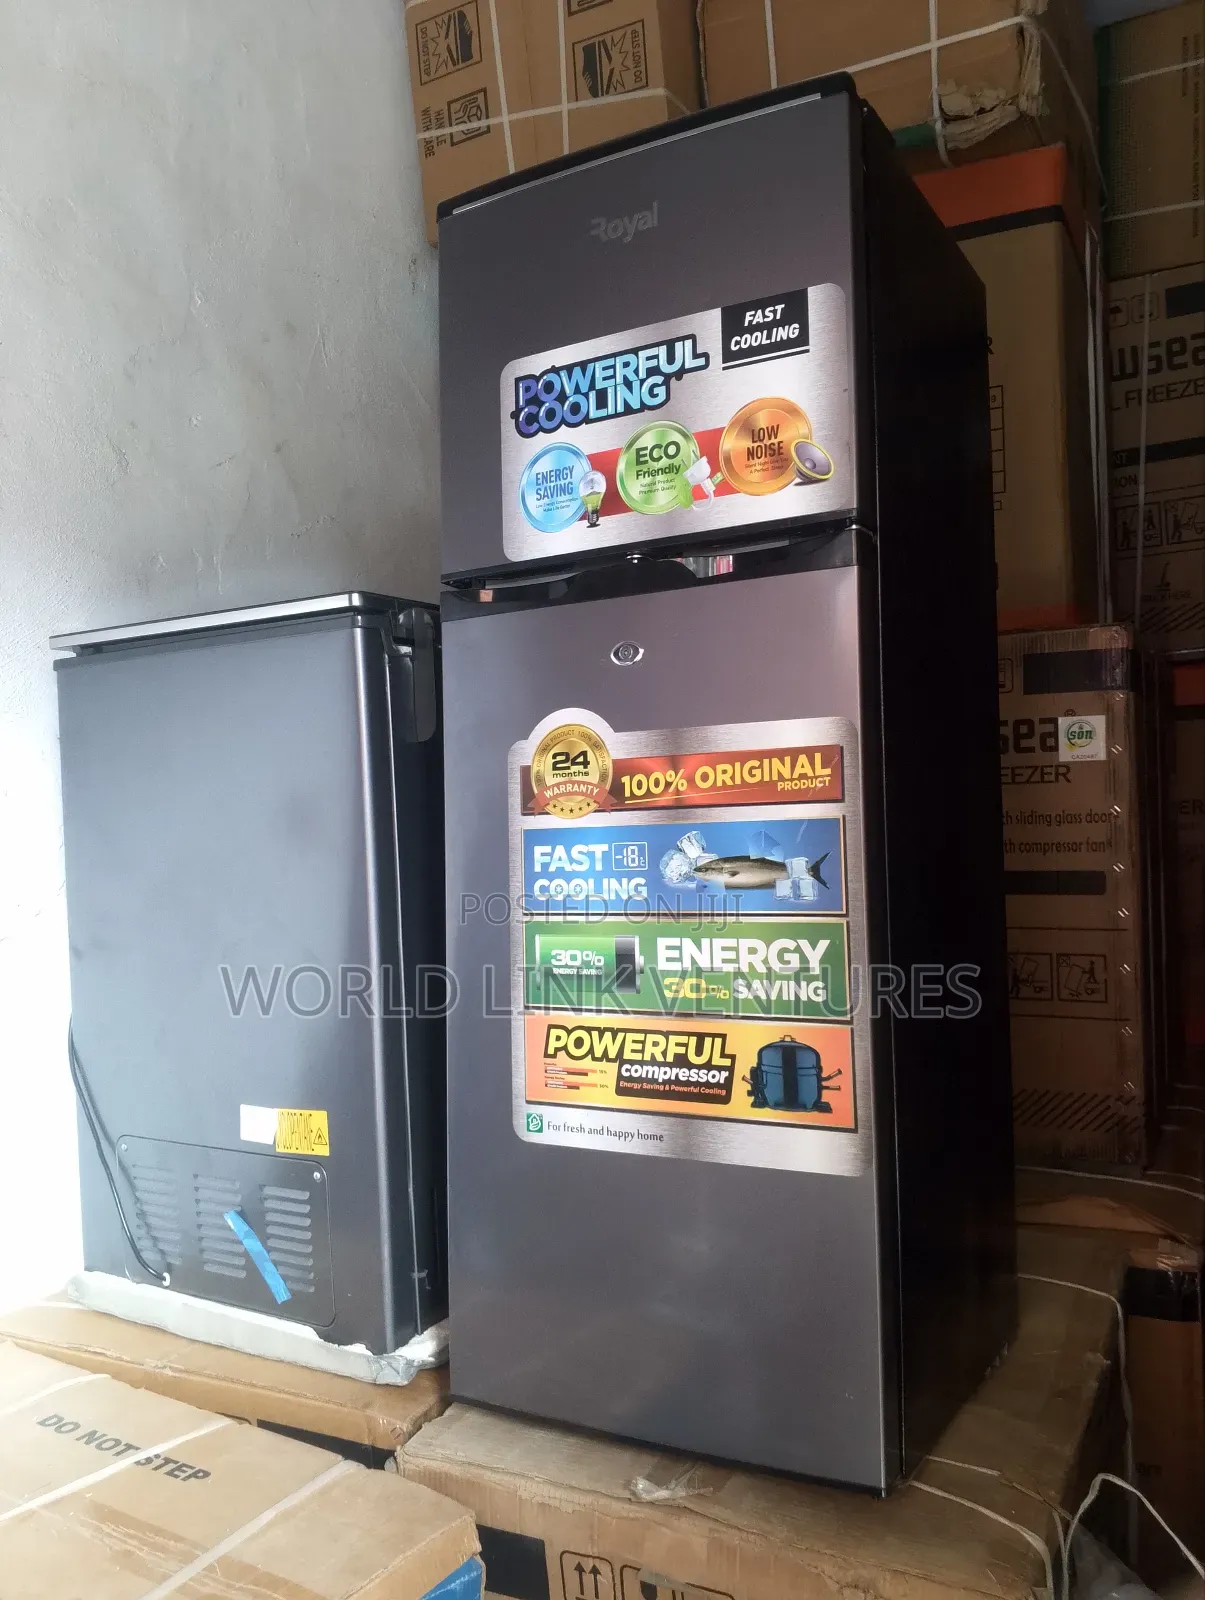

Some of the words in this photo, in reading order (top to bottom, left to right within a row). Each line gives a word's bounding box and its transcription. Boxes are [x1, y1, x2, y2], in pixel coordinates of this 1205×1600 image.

[434, 108, 447, 147] HANLE
[590, 200, 659, 243] Royal
[744, 303, 785, 327] FAST
[730, 323, 800, 351] COOLING
[518, 338, 706, 410] POWERFUL
[517, 375, 667, 435] COOLING
[751, 424, 780, 444] LOW
[635, 440, 681, 467] ECO
[746, 440, 784, 461] NOISE
[535, 465, 575, 487] ENERGY
[635, 463, 681, 480] Friendly
[535, 481, 574, 501] SAVING
[550, 729, 575, 743] PRODUCT
[552, 750, 590, 771] 24
[552, 770, 590, 778] months
[621, 768, 688, 797] 100%
[694, 752, 832, 789] ORIGINAL
[777, 776, 831, 792] PRODUCT
[543, 783, 600, 799] WARRANTY
[1015, 809, 1052, 827] sliding
[1054, 809, 1083, 827] glass
[533, 843, 609, 872] FAST
[1018, 840, 1084, 856] compressor
[533, 877, 648, 901] COOLING
[551, 949, 605, 966] 30%
[656, 937, 831, 975] ENERGY
[552, 967, 578, 975] ENERGY
[663, 977, 730, 999] 30%
[733, 976, 827, 1002] SAVING
[547, 1027, 732, 1067] POWERFUL
[621, 1063, 729, 1084] compressor
[619, 1080, 642, 1090] Energy
[642, 1082, 664, 1091] Saving
[670, 1084, 700, 1093] Powerful
[700, 1087, 727, 1096] Cooling
[547, 1121, 562, 1131] For
[563, 1122, 586, 1134] fresh
[587, 1126, 604, 1136] and
[606, 1126, 635, 1142] happy
[637, 1129, 664, 1142] home
[36, 1413, 82, 1434] DO
[75, 1429, 142, 1457] NOT
